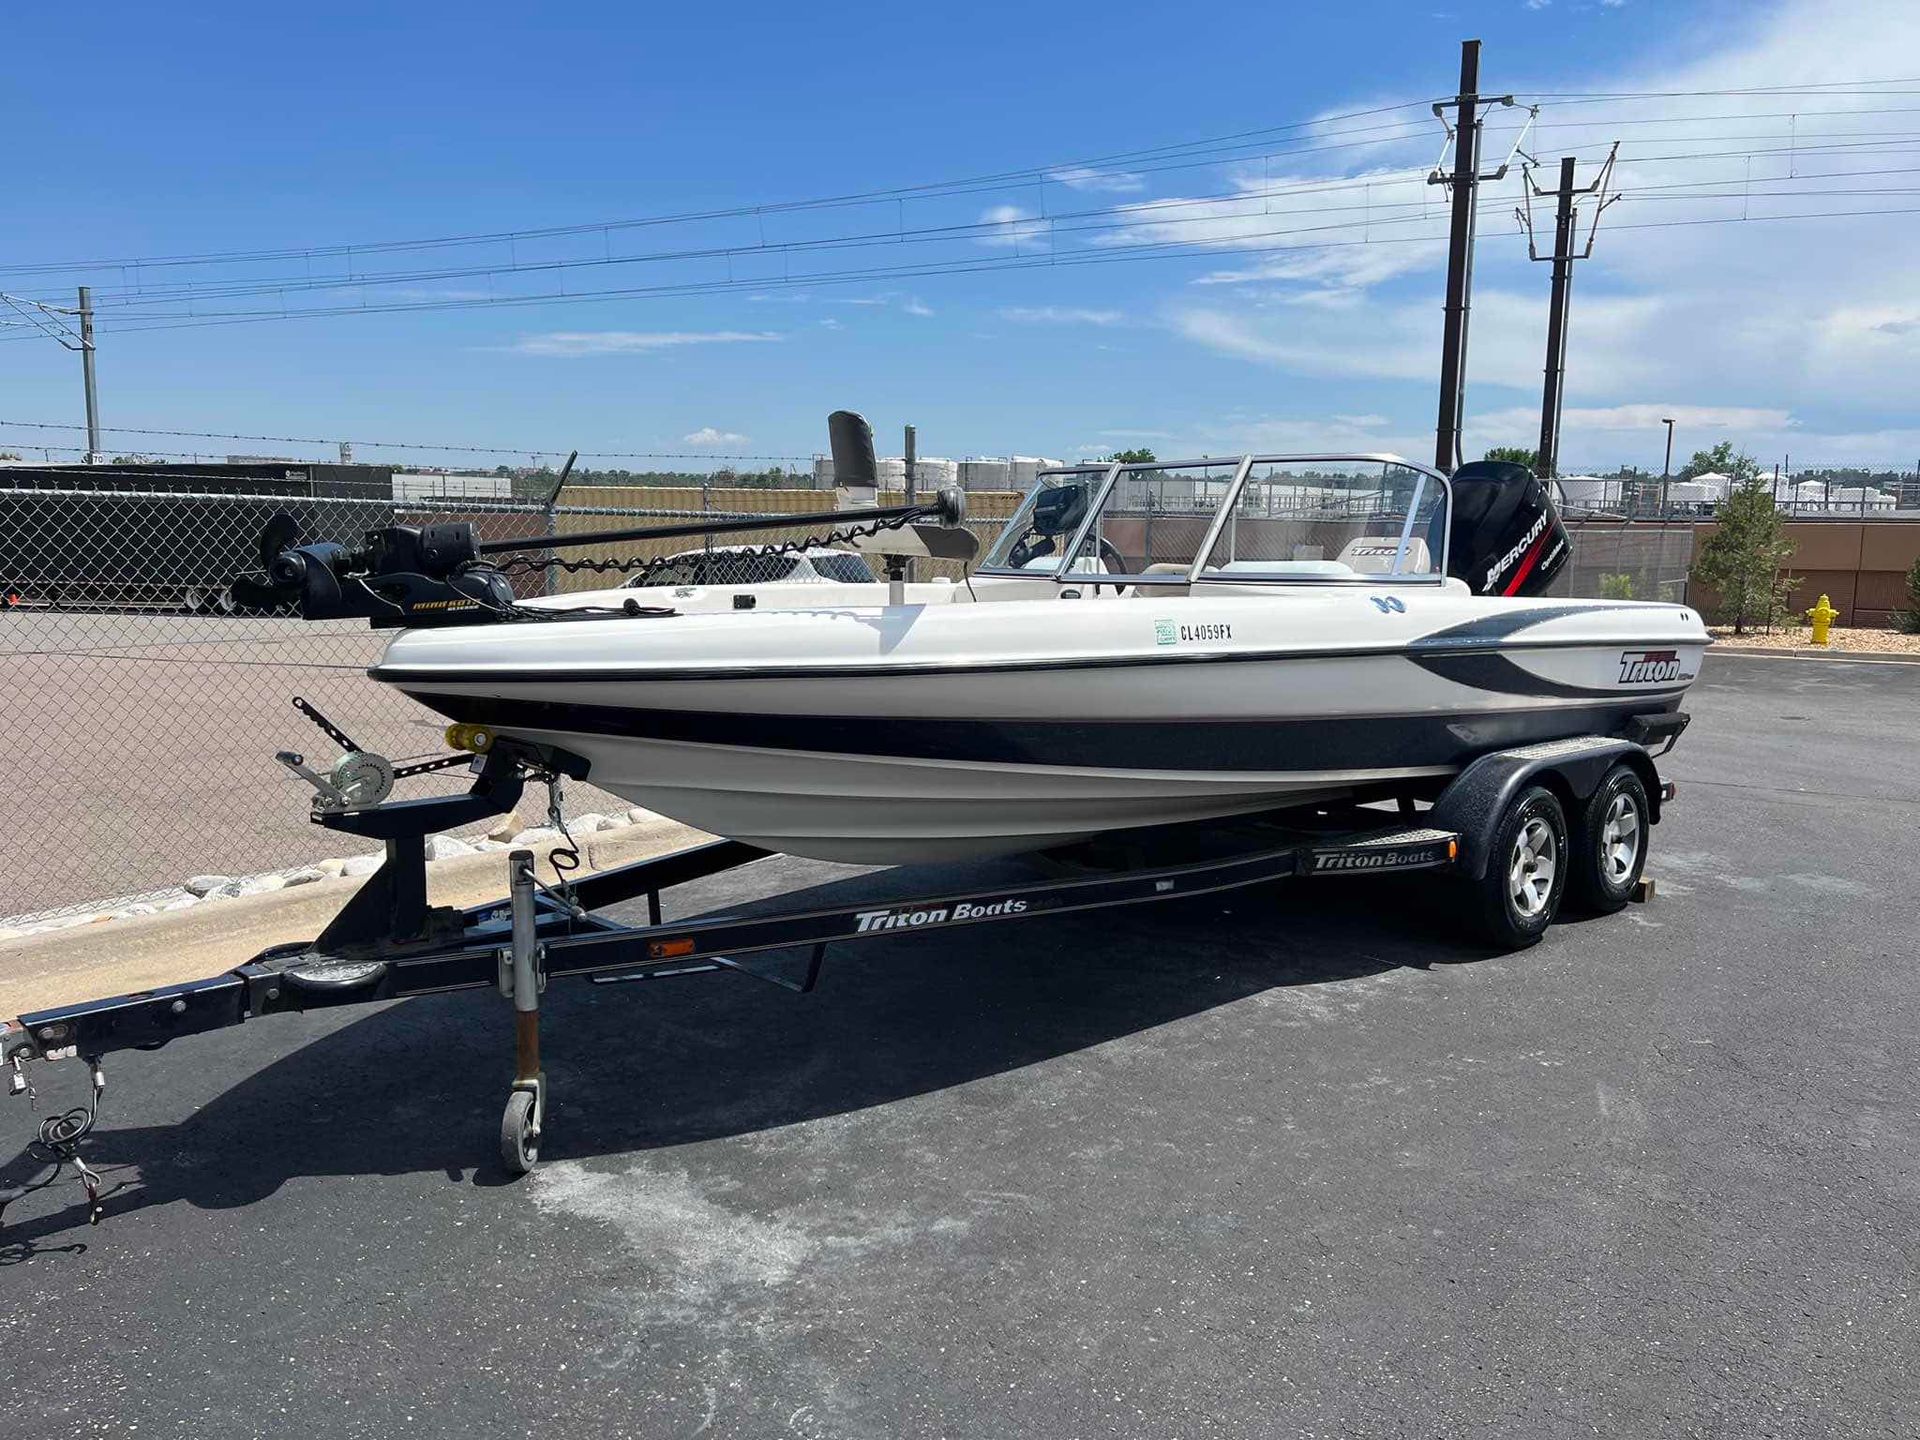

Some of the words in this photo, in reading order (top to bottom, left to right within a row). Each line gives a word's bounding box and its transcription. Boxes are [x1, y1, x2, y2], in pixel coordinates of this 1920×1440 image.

[1482, 508, 1547, 592] MERCURY
[1180, 624, 1232, 641] CL4059FX
[1618, 650, 1680, 683] Triton
[1314, 853, 1382, 869] Triton
[1384, 850, 1435, 865] Boats
[855, 909, 948, 933] Triton
[952, 899, 1028, 920] Boats
